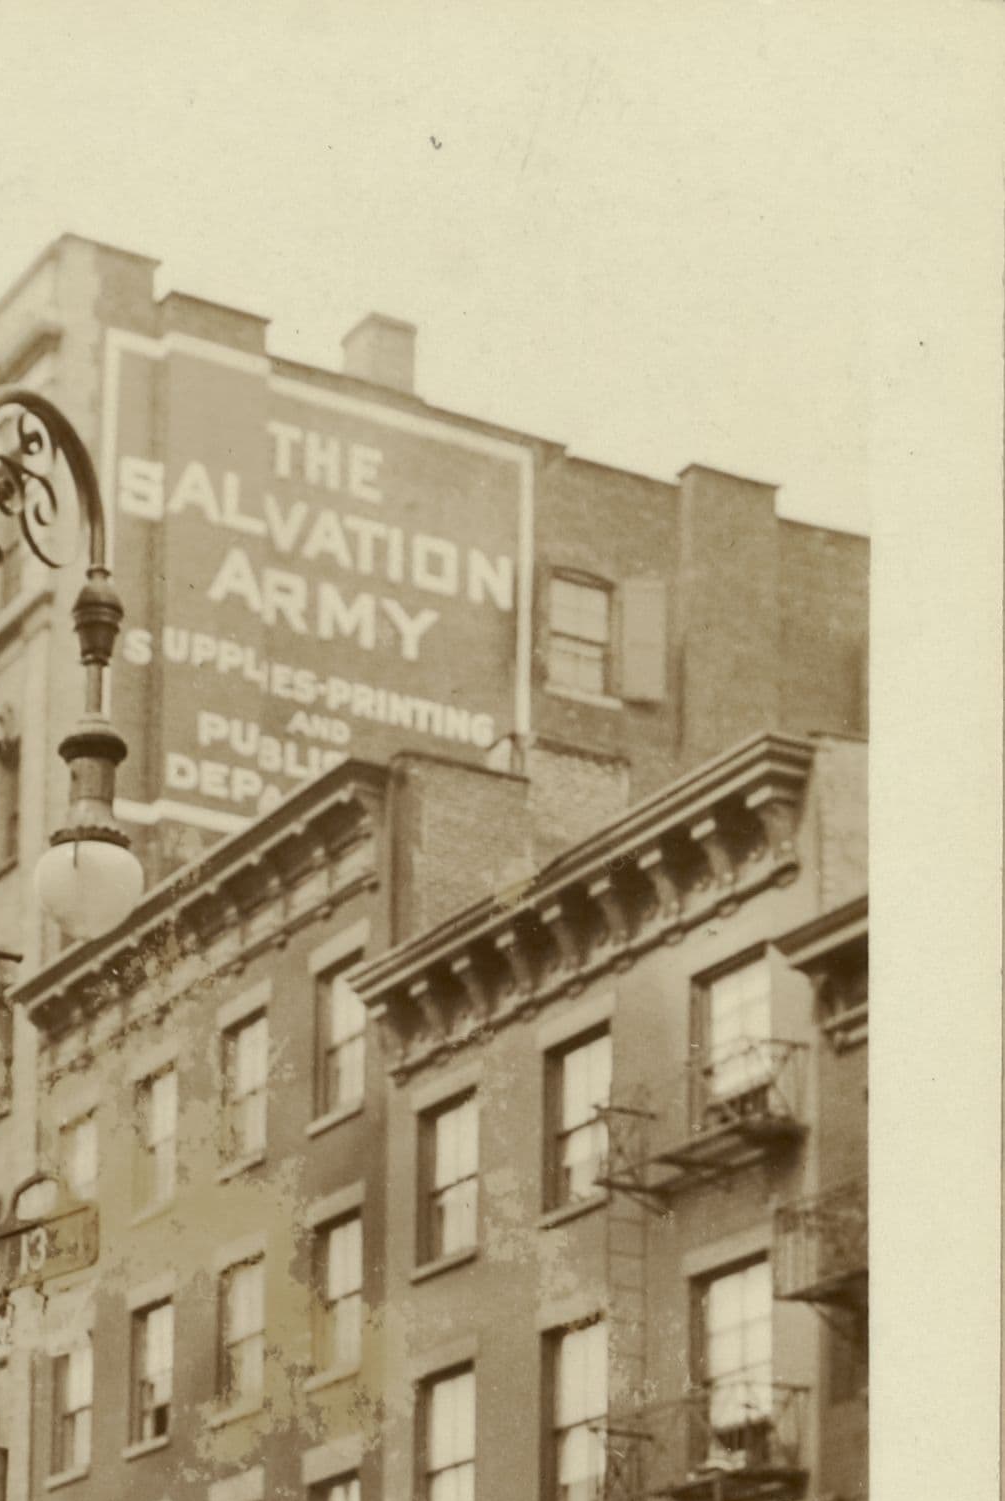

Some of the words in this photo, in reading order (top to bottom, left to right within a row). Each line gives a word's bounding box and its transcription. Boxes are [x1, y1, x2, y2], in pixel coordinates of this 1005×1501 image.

[267, 420, 384, 503] THE
[118, 455, 515, 612] SALVATION
[207, 548, 440, 662] ARMY
[286, 710, 351, 745] AND
[18, 1226, 48, 1276] 13
